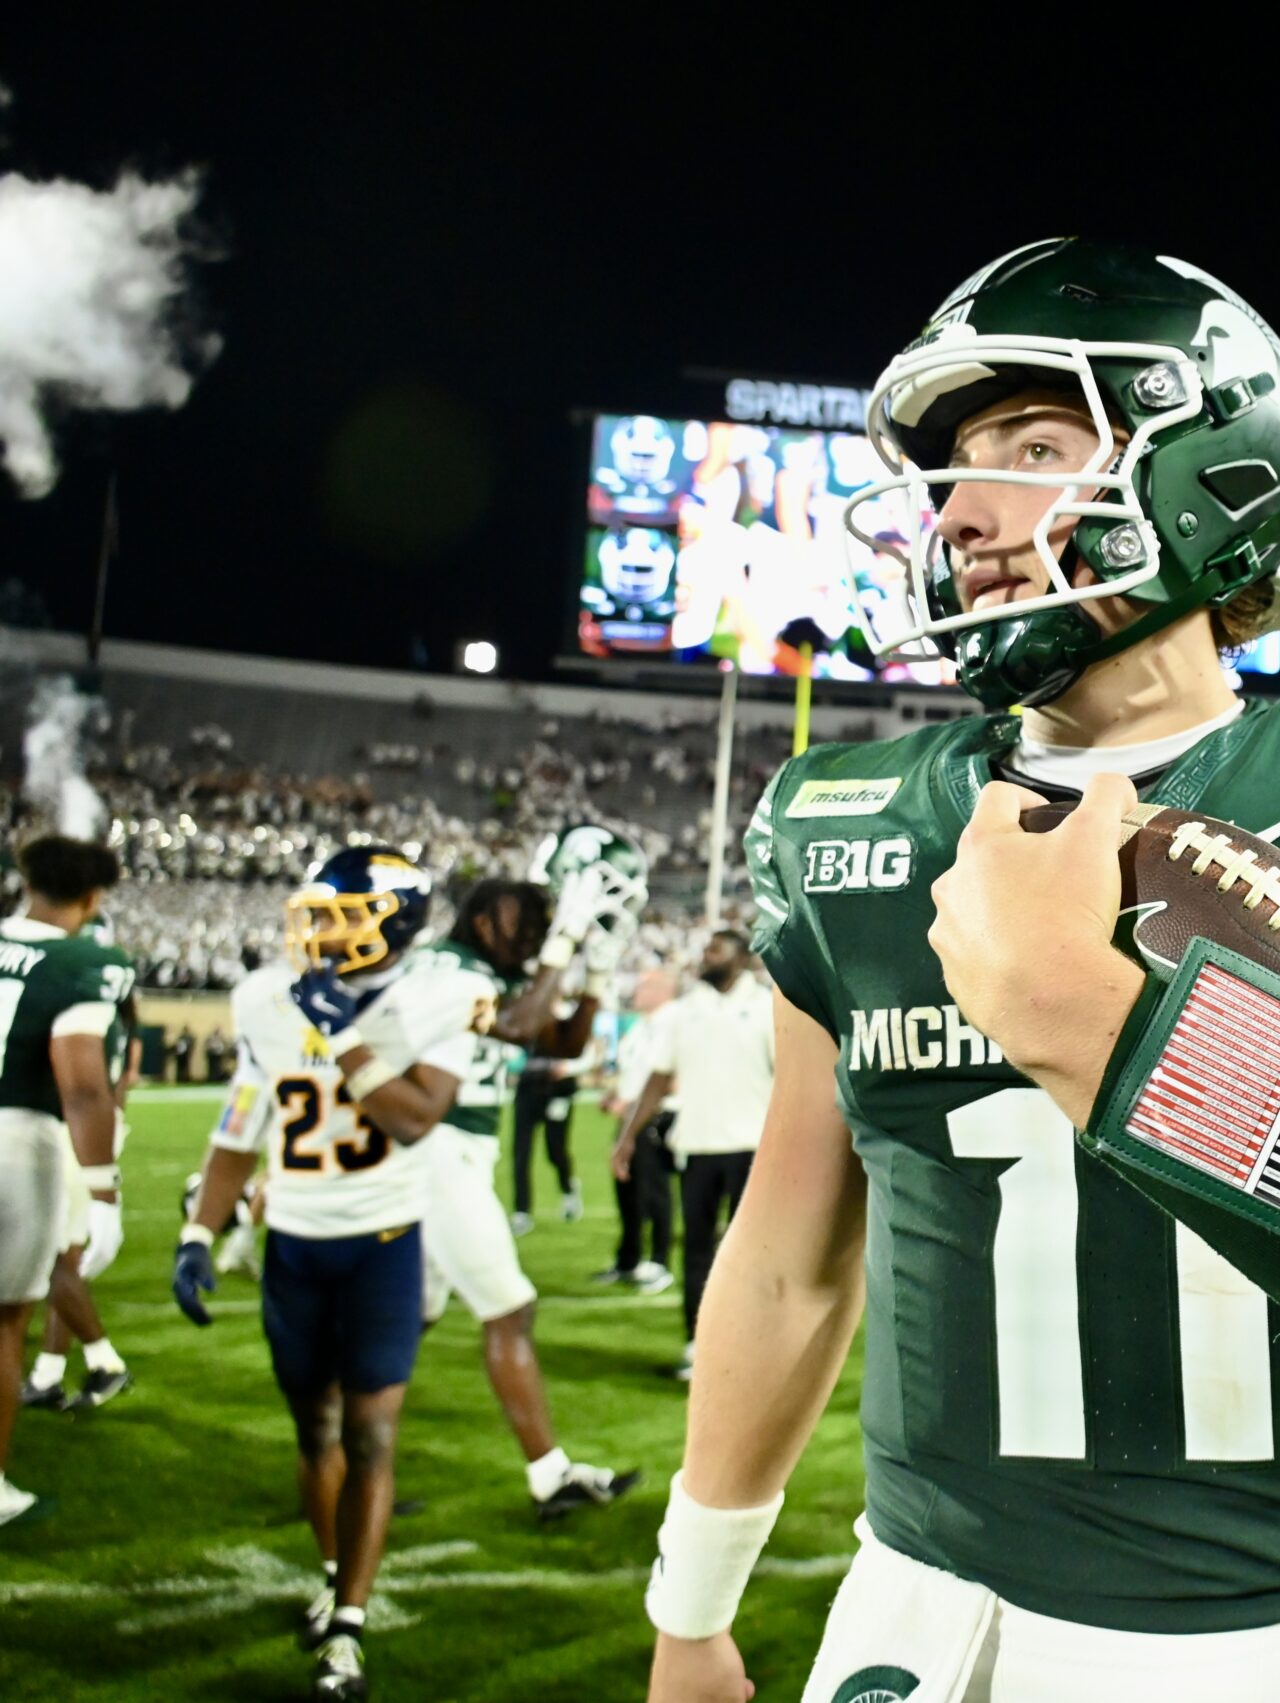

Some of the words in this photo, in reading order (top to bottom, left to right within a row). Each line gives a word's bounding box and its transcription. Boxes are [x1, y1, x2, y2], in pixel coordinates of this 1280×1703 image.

[811, 789, 887, 803] msufcu
[274, 1075, 392, 1174] 23
[946, 1087, 1275, 1462] 11
